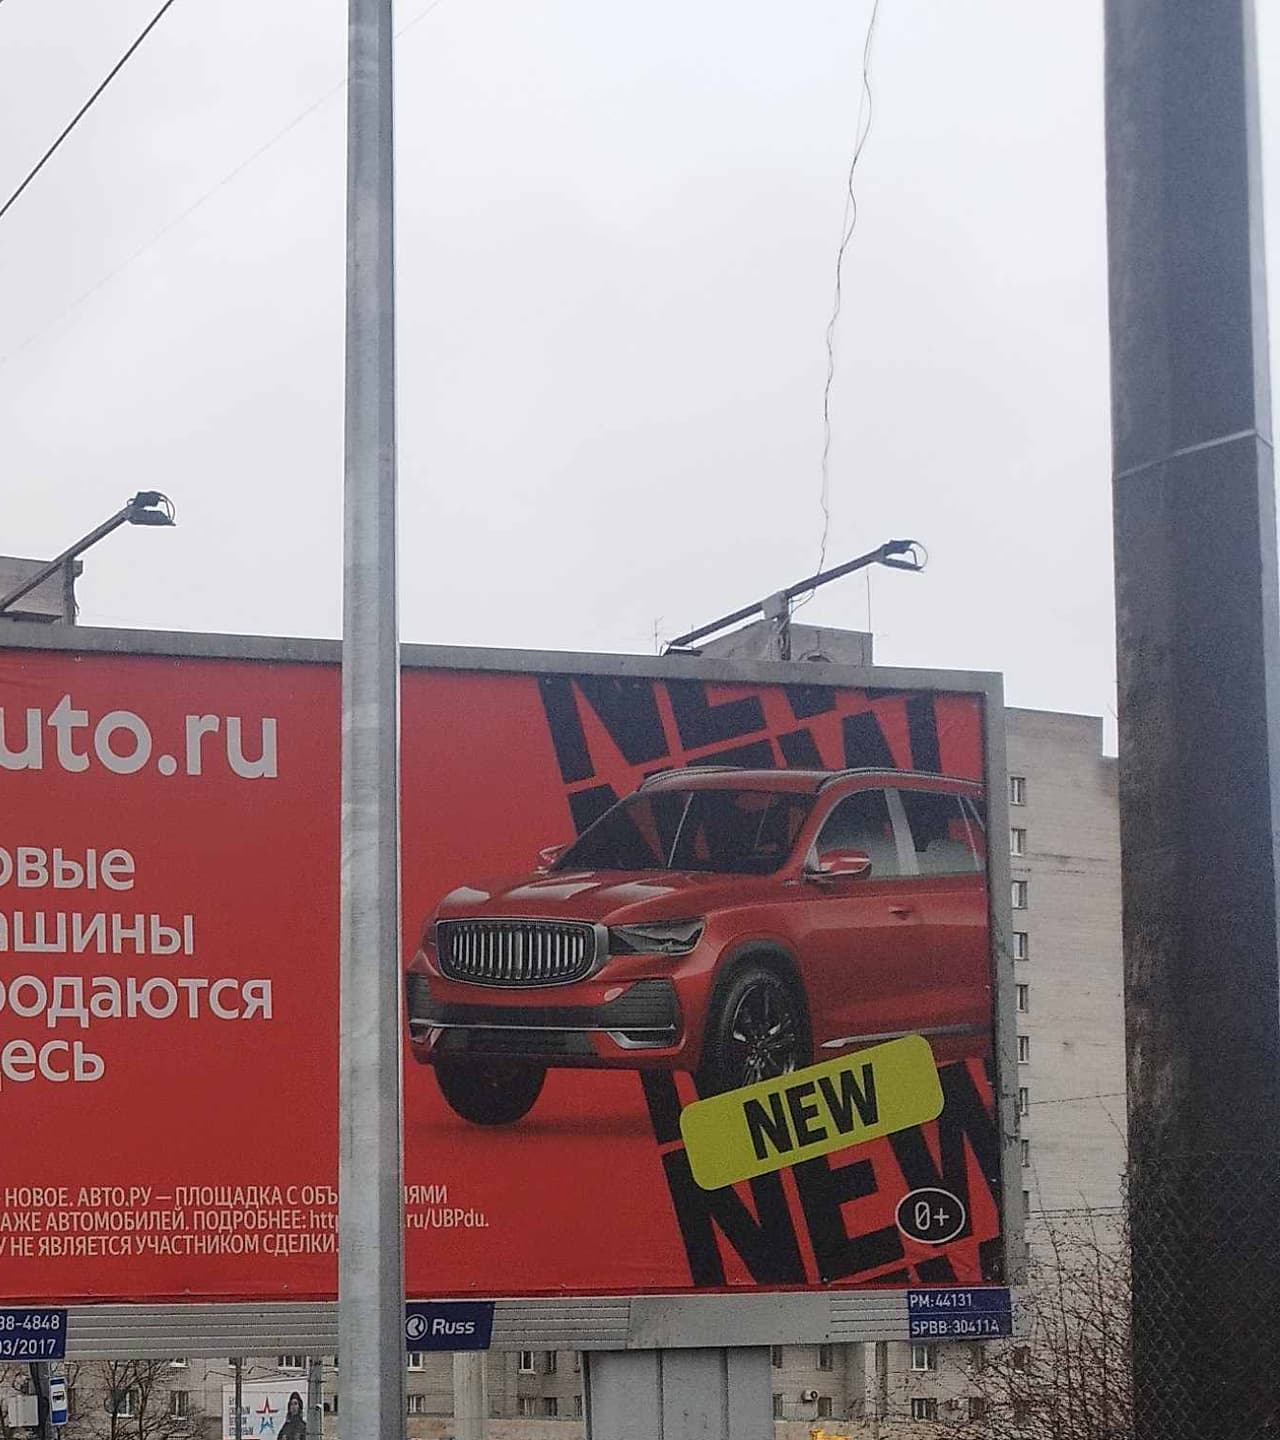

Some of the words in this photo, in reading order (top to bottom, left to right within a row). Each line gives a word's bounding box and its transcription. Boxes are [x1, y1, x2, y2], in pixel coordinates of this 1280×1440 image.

[742, 1063, 879, 1161] NEW
[5, 1187, 74, 1207] НОВОЕ.
[77, 1186, 151, 1207] АВТО.РУ
[176, 1186, 282, 1209] ПЛОЩАДКА
[287, 1186, 298, 1205] С
[46, 1205, 190, 1232] АВТОМОБИЛЕЙ.
[193, 1210, 307, 1234] ПОДРОБНЕЕ:
[914, 1200, 950, 1231] 0+
[11, 1236, 35, 1257] НЕ
[38, 1235, 132, 1256] ЯВЛЯЕТСЯ
[136, 1234, 259, 1255] УЧАСТНИКОМ
[263, 1232, 339, 1256] СДЕЛКИ.
[431, 1318, 476, 1336] Russ
